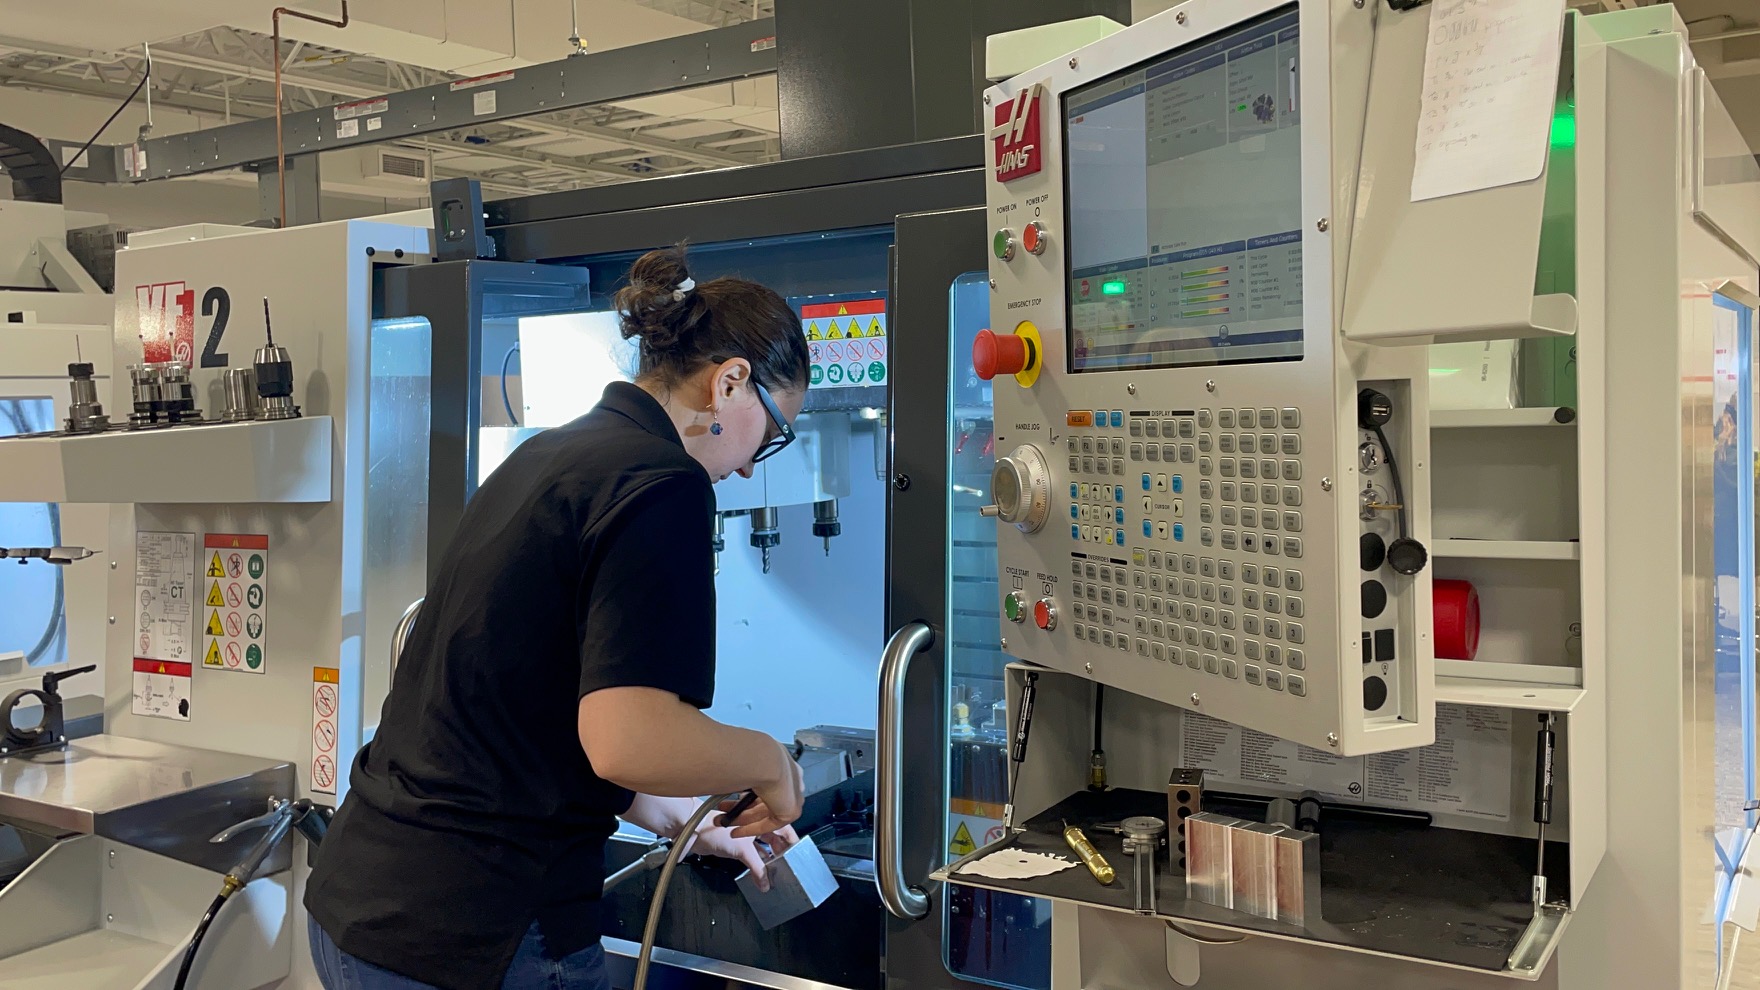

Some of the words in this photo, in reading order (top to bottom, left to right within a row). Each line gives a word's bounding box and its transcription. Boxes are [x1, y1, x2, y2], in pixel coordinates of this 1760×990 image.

[995, 144, 1034, 174] HAAS
[1026, 196, 1040, 206] POWER
[996, 204, 1010, 214] POWER
[1008, 300, 1030, 309] EMERGENCY
[1032, 298, 1041, 306] STOP
[201, 286, 230, 368] 2
[1088, 554, 1109, 562] OVERRIDES
[170, 586, 184, 598] CT
